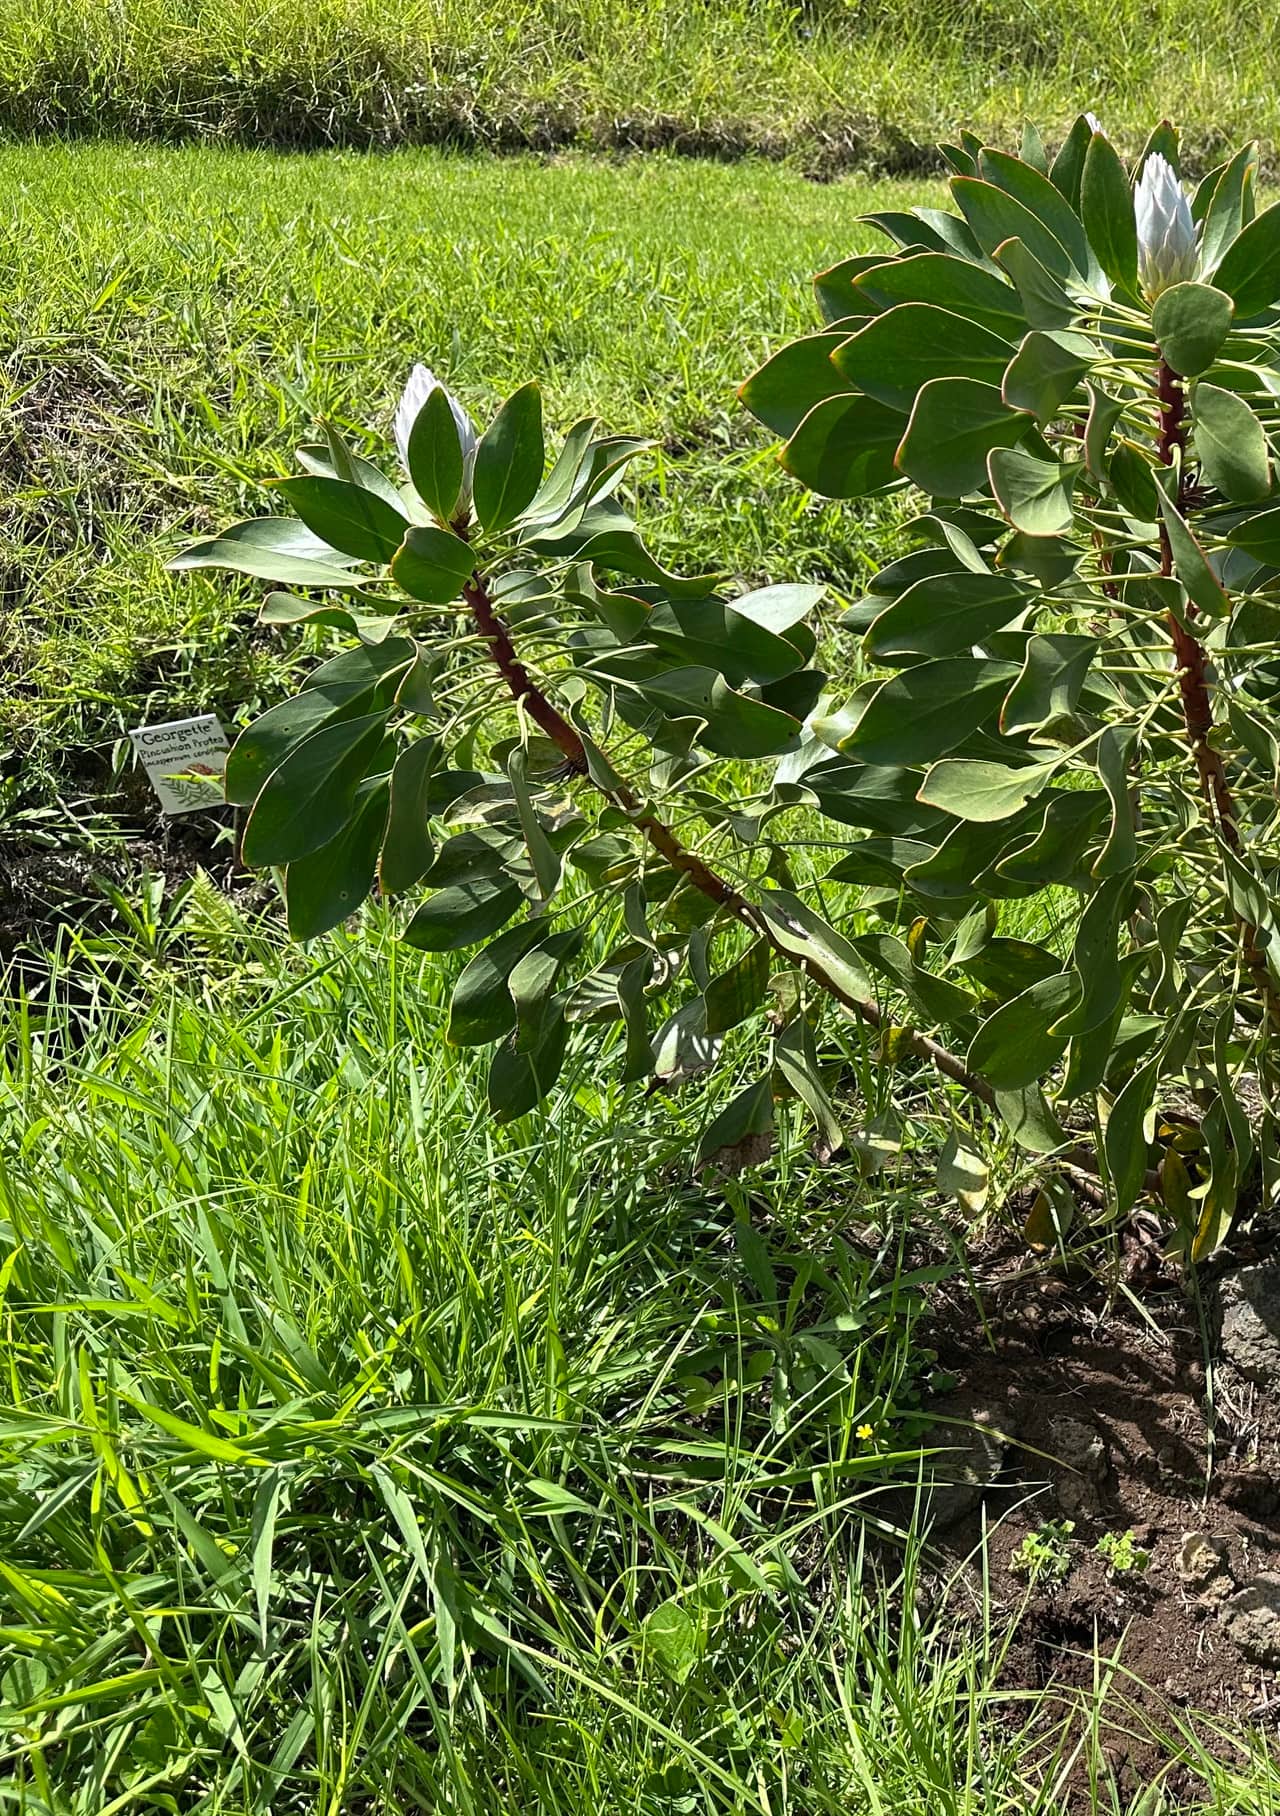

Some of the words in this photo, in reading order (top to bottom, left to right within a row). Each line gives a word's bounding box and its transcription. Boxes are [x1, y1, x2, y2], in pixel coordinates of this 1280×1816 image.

[134, 720, 214, 745] "Georgette"
[140, 743, 191, 759] Pincushion
[192, 736, 224, 748] Protea
